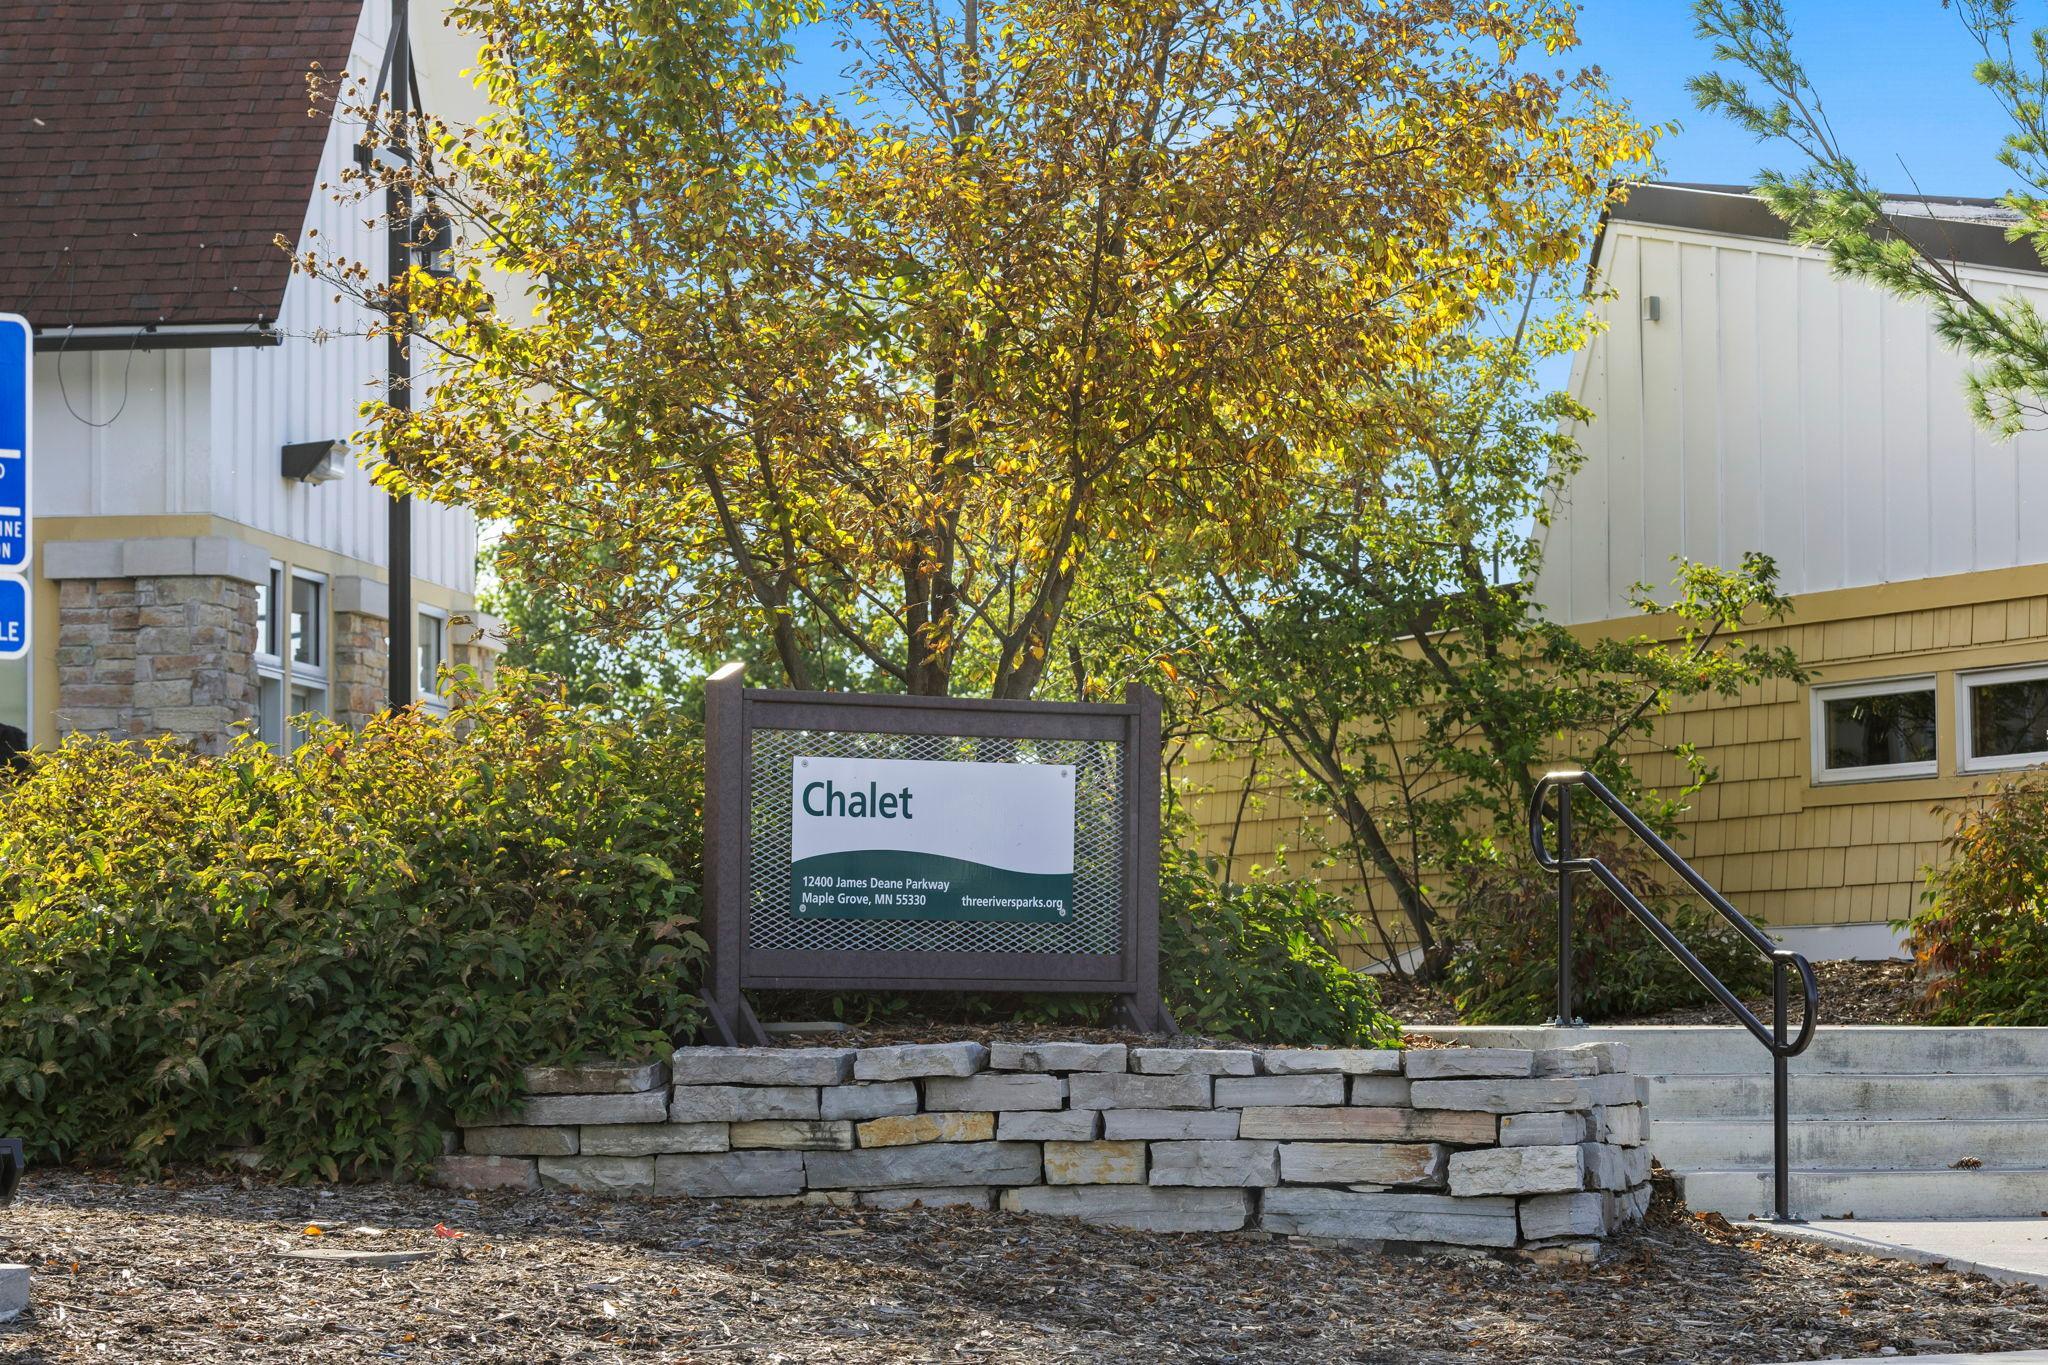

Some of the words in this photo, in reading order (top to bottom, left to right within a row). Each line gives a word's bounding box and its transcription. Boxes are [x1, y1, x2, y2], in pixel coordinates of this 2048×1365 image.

[802, 780, 913, 820] Chalet
[802, 876, 834, 888] 12400
[835, 876, 868, 889] James
[870, 877, 903, 889] Deane
[905, 878, 950, 892] Parkway
[802, 892, 835, 906] Maple
[837, 893, 872, 906] Grove,
[874, 893, 893, 905] MN
[895, 894, 927, 906] 55330
[961, 895, 1063, 911] threeriversparks.org
